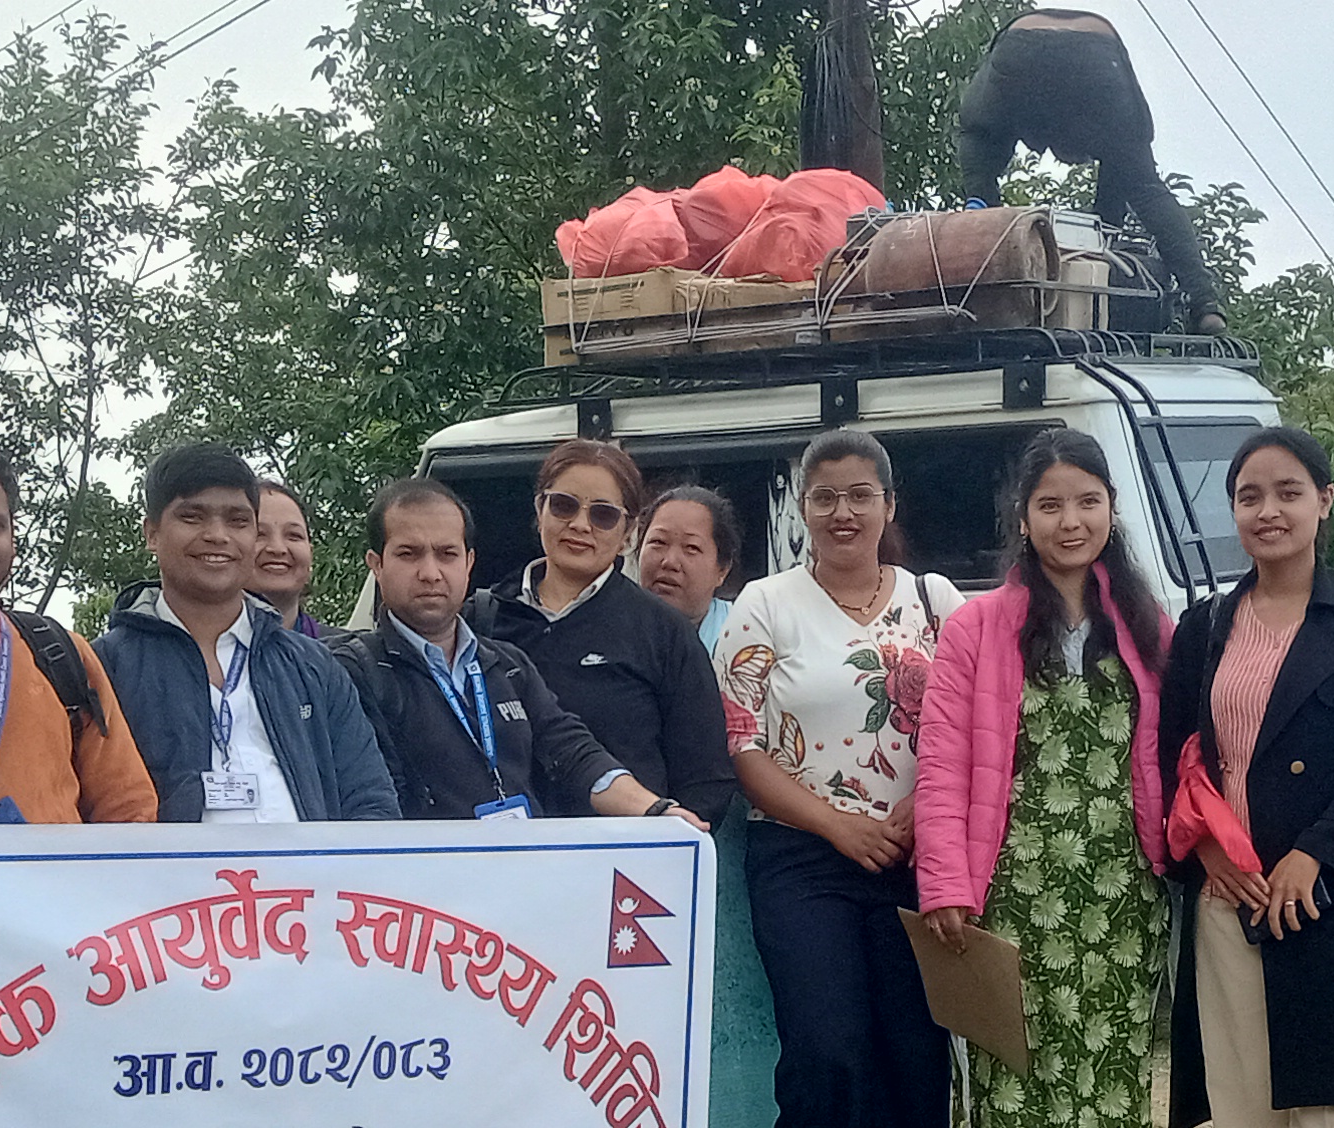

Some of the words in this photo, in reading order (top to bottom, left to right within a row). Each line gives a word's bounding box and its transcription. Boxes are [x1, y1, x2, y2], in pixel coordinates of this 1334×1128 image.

[67, 868, 315, 1007] आयुर्वेद
[335, 889, 558, 1029] स्वास्थ्य
[113, 1050, 225, 1098] आ.व.
[240, 1034, 452, 1090] २०८२/०८३
